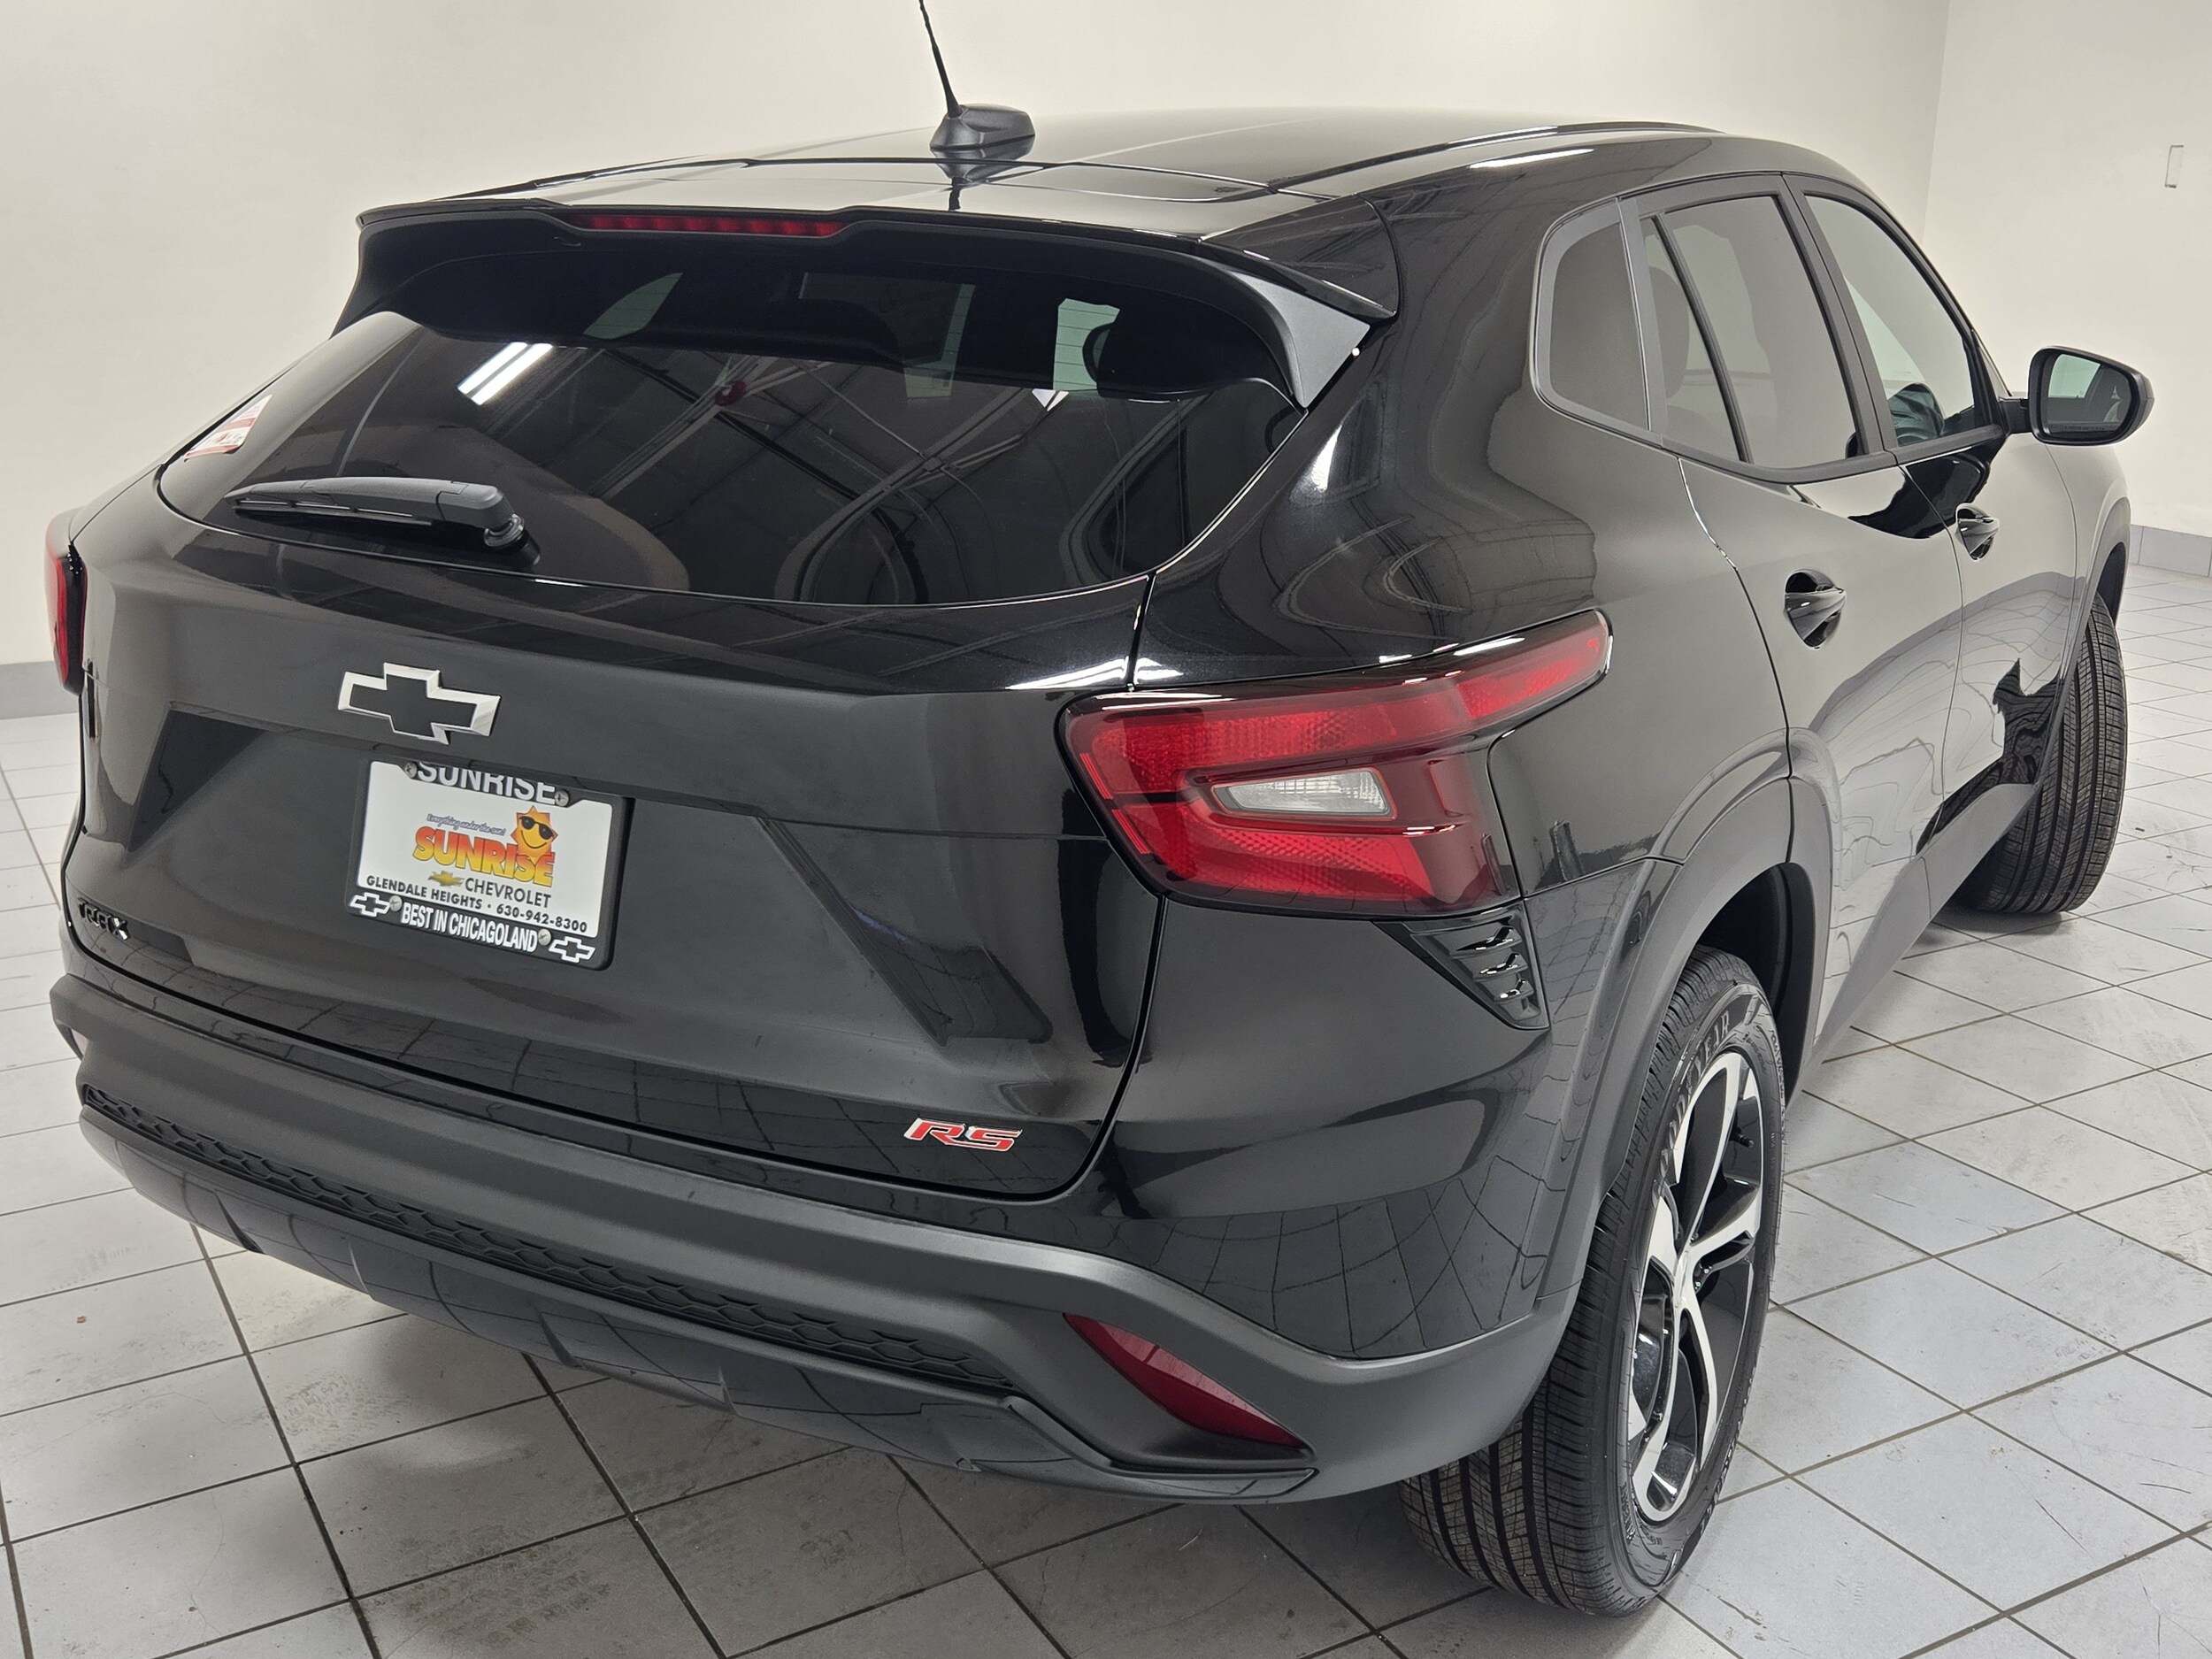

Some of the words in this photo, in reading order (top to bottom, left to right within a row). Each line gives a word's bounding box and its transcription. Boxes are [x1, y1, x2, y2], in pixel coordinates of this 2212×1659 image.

[418, 761, 556, 805] SUNRISE
[413, 826, 556, 888] SUNRISE
[366, 875, 428, 898] GLENDALE
[430, 888, 483, 910] HEIGHTS
[496, 903, 588, 933] 630-942-8300
[465, 877, 551, 909] CHEVROLET
[401, 902, 434, 928] BEST
[434, 909, 449, 933] IN
[449, 912, 538, 953] CHICAGOLAND
[903, 1118, 1023, 1152] RS
